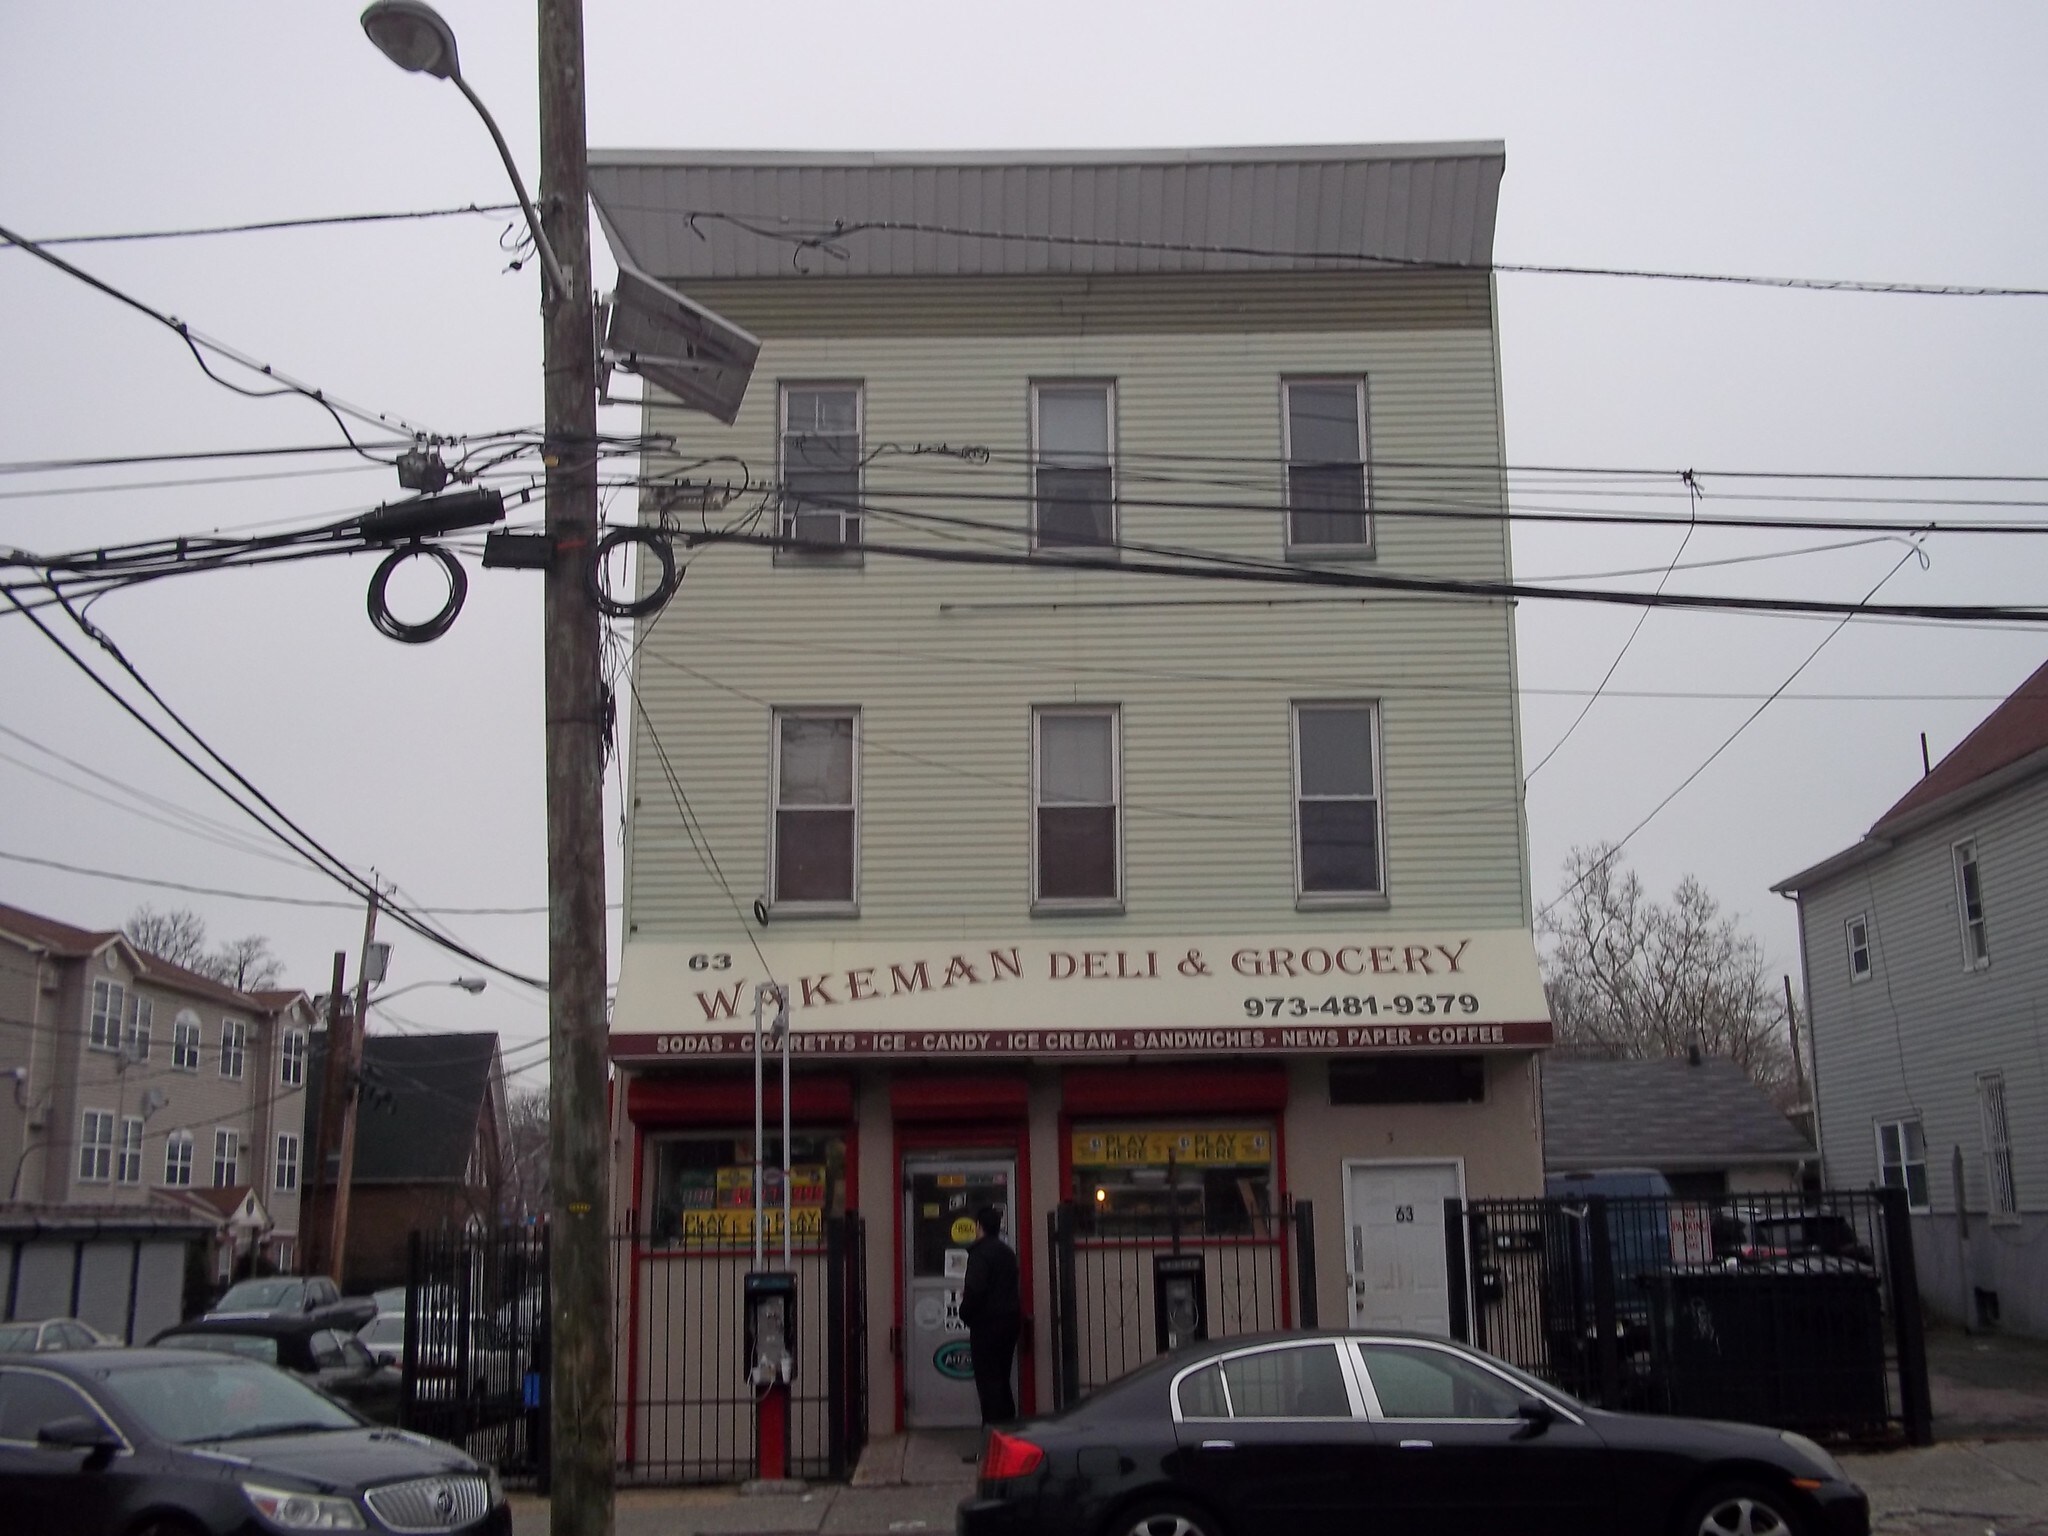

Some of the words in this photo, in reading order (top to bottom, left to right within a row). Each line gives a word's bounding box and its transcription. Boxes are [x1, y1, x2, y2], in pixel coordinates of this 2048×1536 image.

[688, 953, 733, 971] 63
[694, 947, 1024, 1022] WAKEMAN
[1049, 951, 1159, 979] DELI
[1177, 949, 1212, 977] &
[1231, 939, 1470, 977] GROCERY
[1243, 993, 1480, 1018] 973-481-9379
[657, 1035, 723, 1054] SODAS
[740, 1033, 856, 1053] CGARETTS
[872, 1034, 906, 1051] ICE
[922, 1033, 991, 1050] CANDY
[1007, 1033, 1040, 1050] ICE
[1045, 1032, 1117, 1050] CREAM
[1133, 1030, 1265, 1049] SANDWICHES
[1282, 1029, 1339, 1047] NEWS
[1347, 1027, 1412, 1046] PAPER
[1428, 1026, 1504, 1044] COFFEE
[1106, 1135, 1148, 1148] PLAY
[1195, 1134, 1237, 1148] PLAY
[1106, 1147, 1147, 1160] HERE
[1195, 1146, 1237, 1159] HERE
[775, 1211, 818, 1224] PAY
[1396, 1206, 1414, 1223] 63
